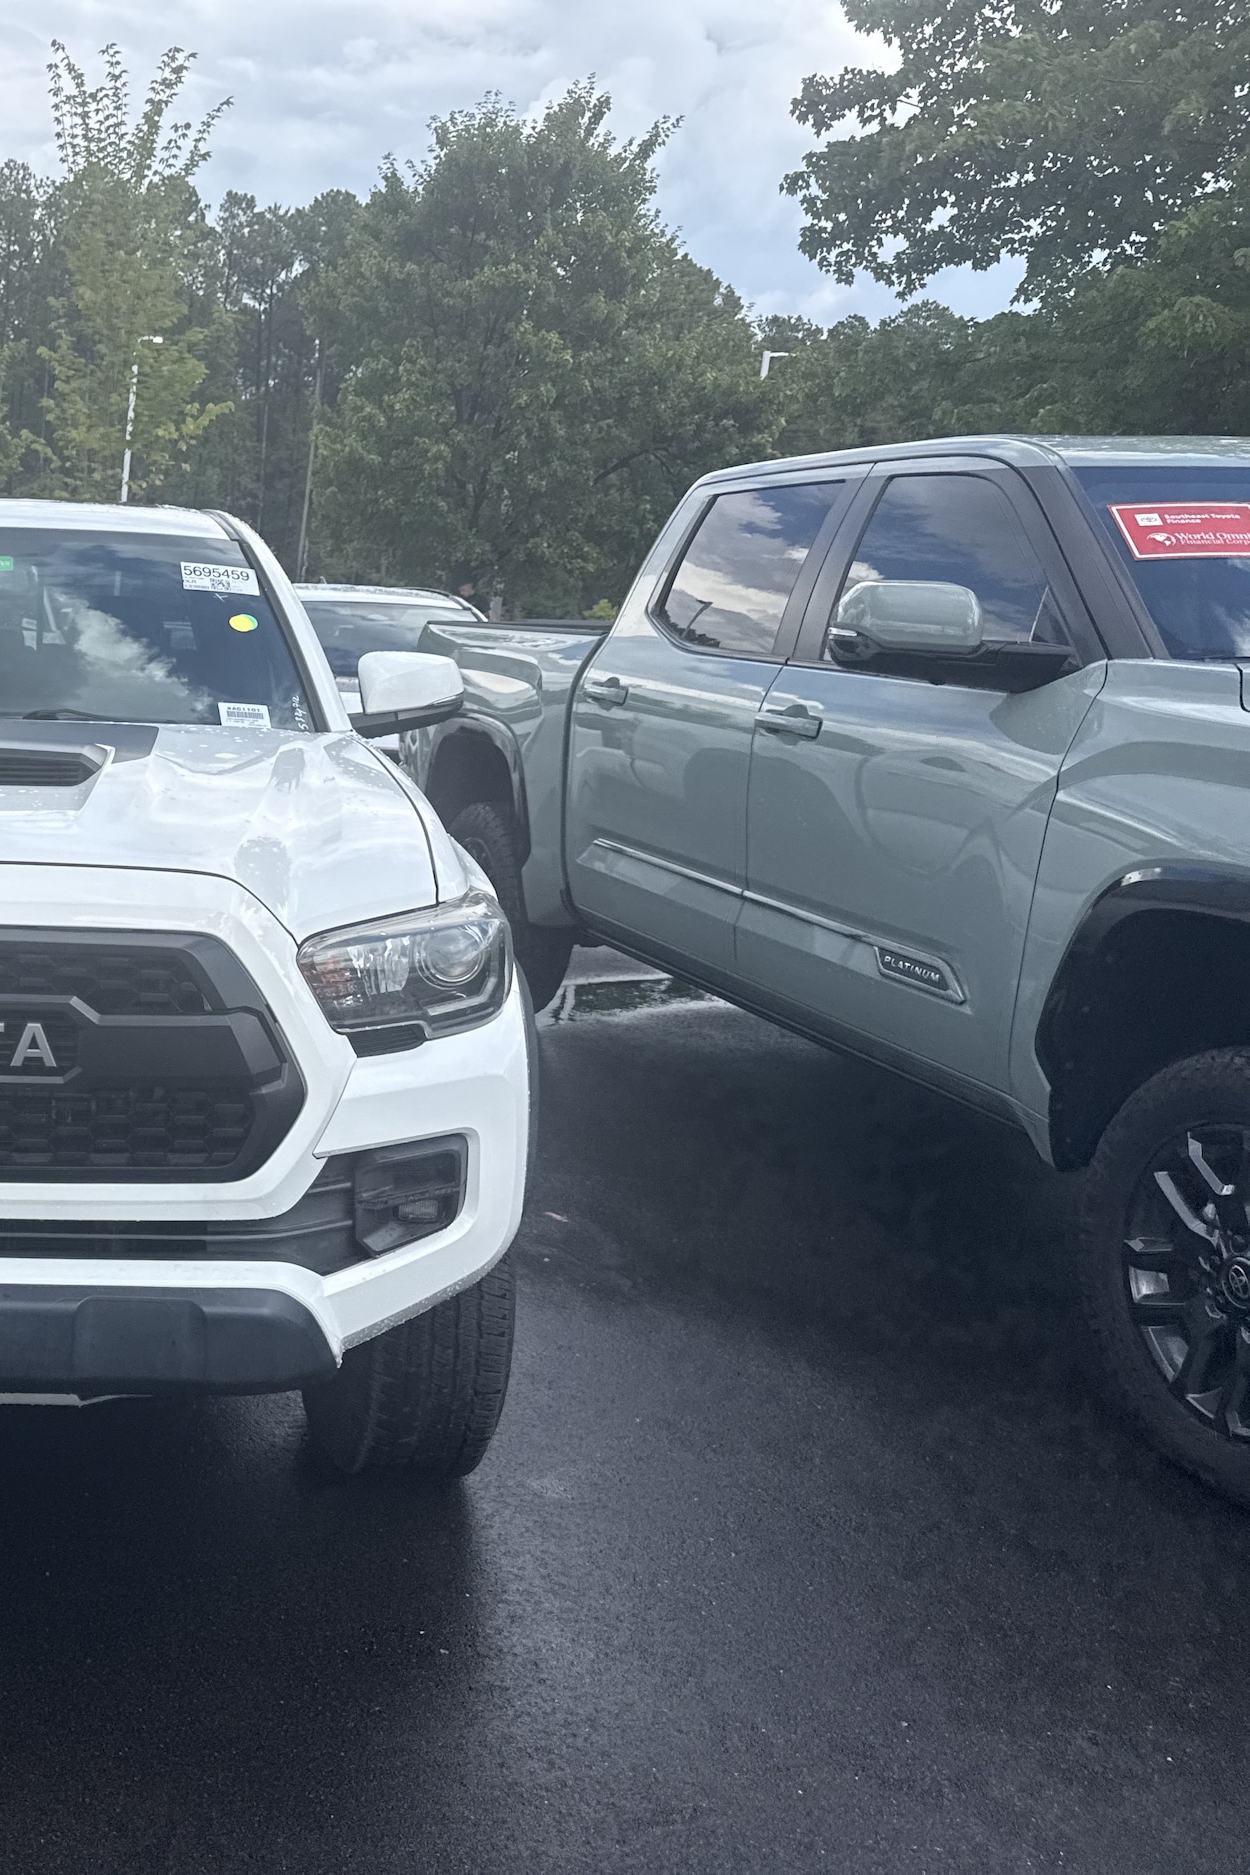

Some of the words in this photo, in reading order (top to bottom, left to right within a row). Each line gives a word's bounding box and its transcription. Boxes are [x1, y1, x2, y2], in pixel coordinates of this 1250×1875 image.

[1174, 532, 1215, 540] World
[183, 565, 250, 581] 5695459
[883, 955, 941, 983] PLATINUM
